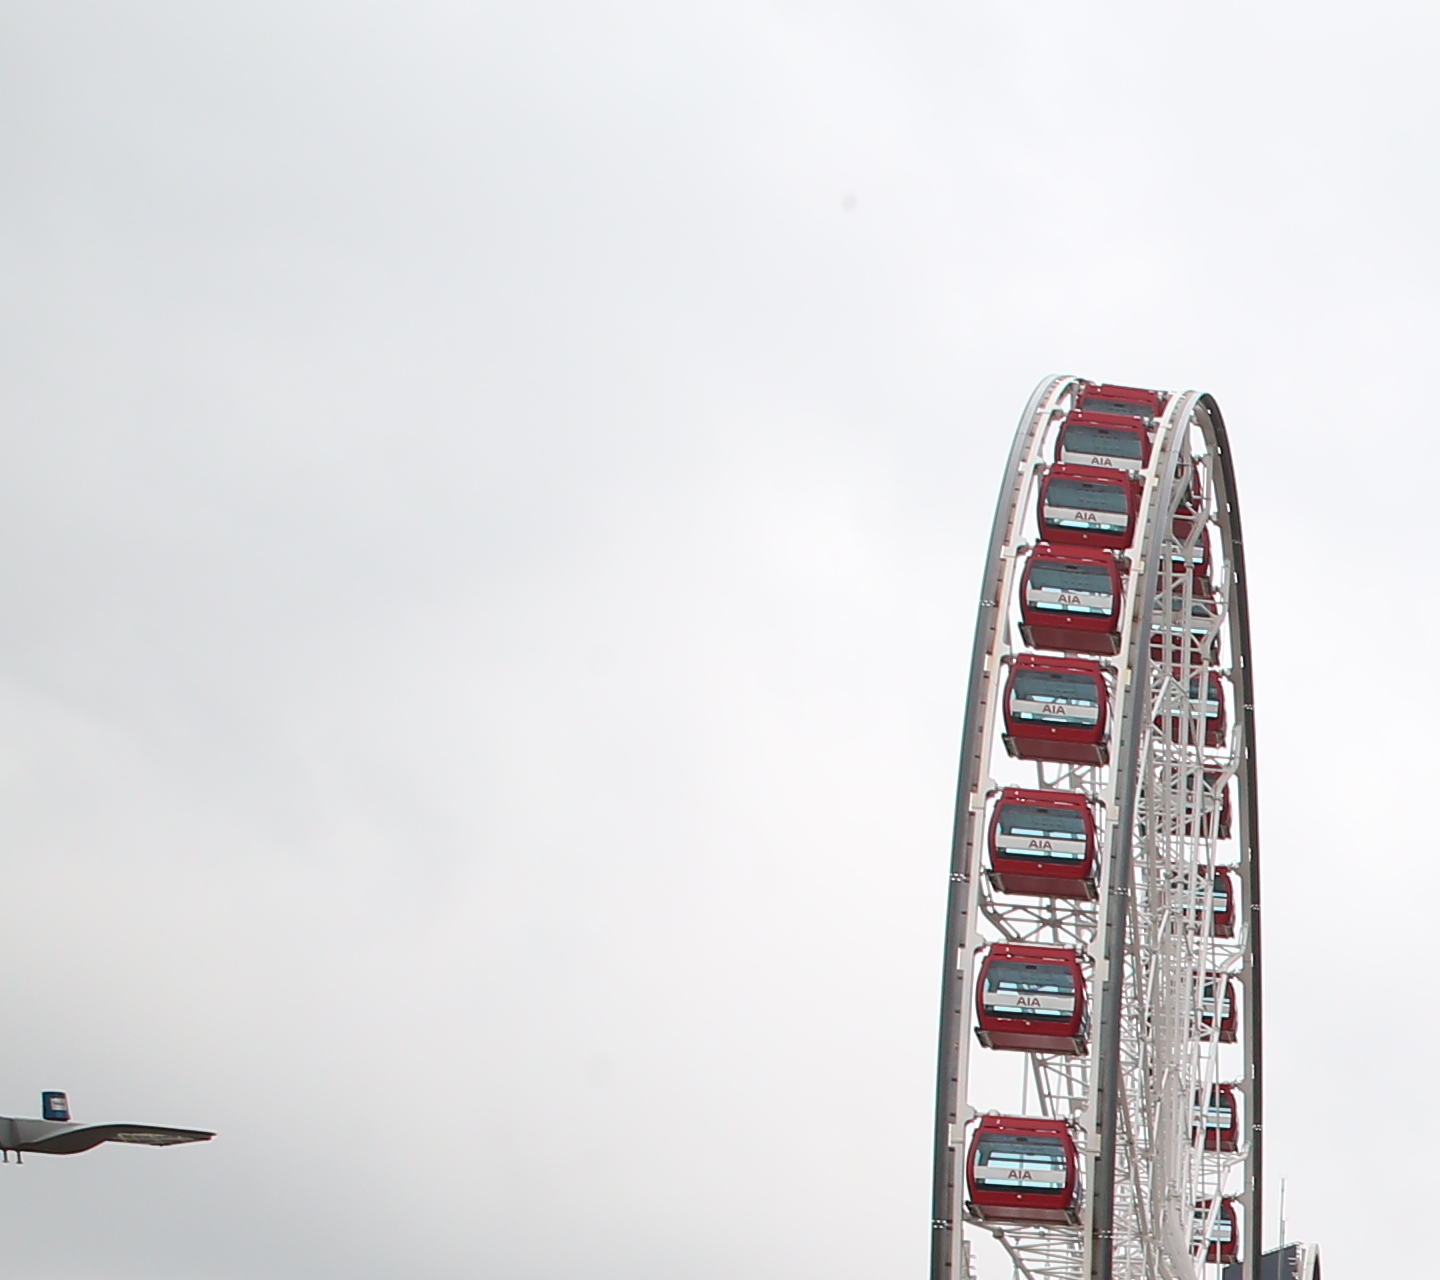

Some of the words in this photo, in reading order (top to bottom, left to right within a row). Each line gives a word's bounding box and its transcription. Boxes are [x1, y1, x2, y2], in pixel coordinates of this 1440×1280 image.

[1091, 457, 1112, 467] AIA
[1074, 511, 1097, 522] AIA
[1058, 594, 1081, 604] AIA
[1042, 704, 1066, 715] AIA
[1028, 840, 1053, 850] AIA
[1017, 997, 1040, 1007] AIA
[1008, 1170, 1032, 1180] AIA
